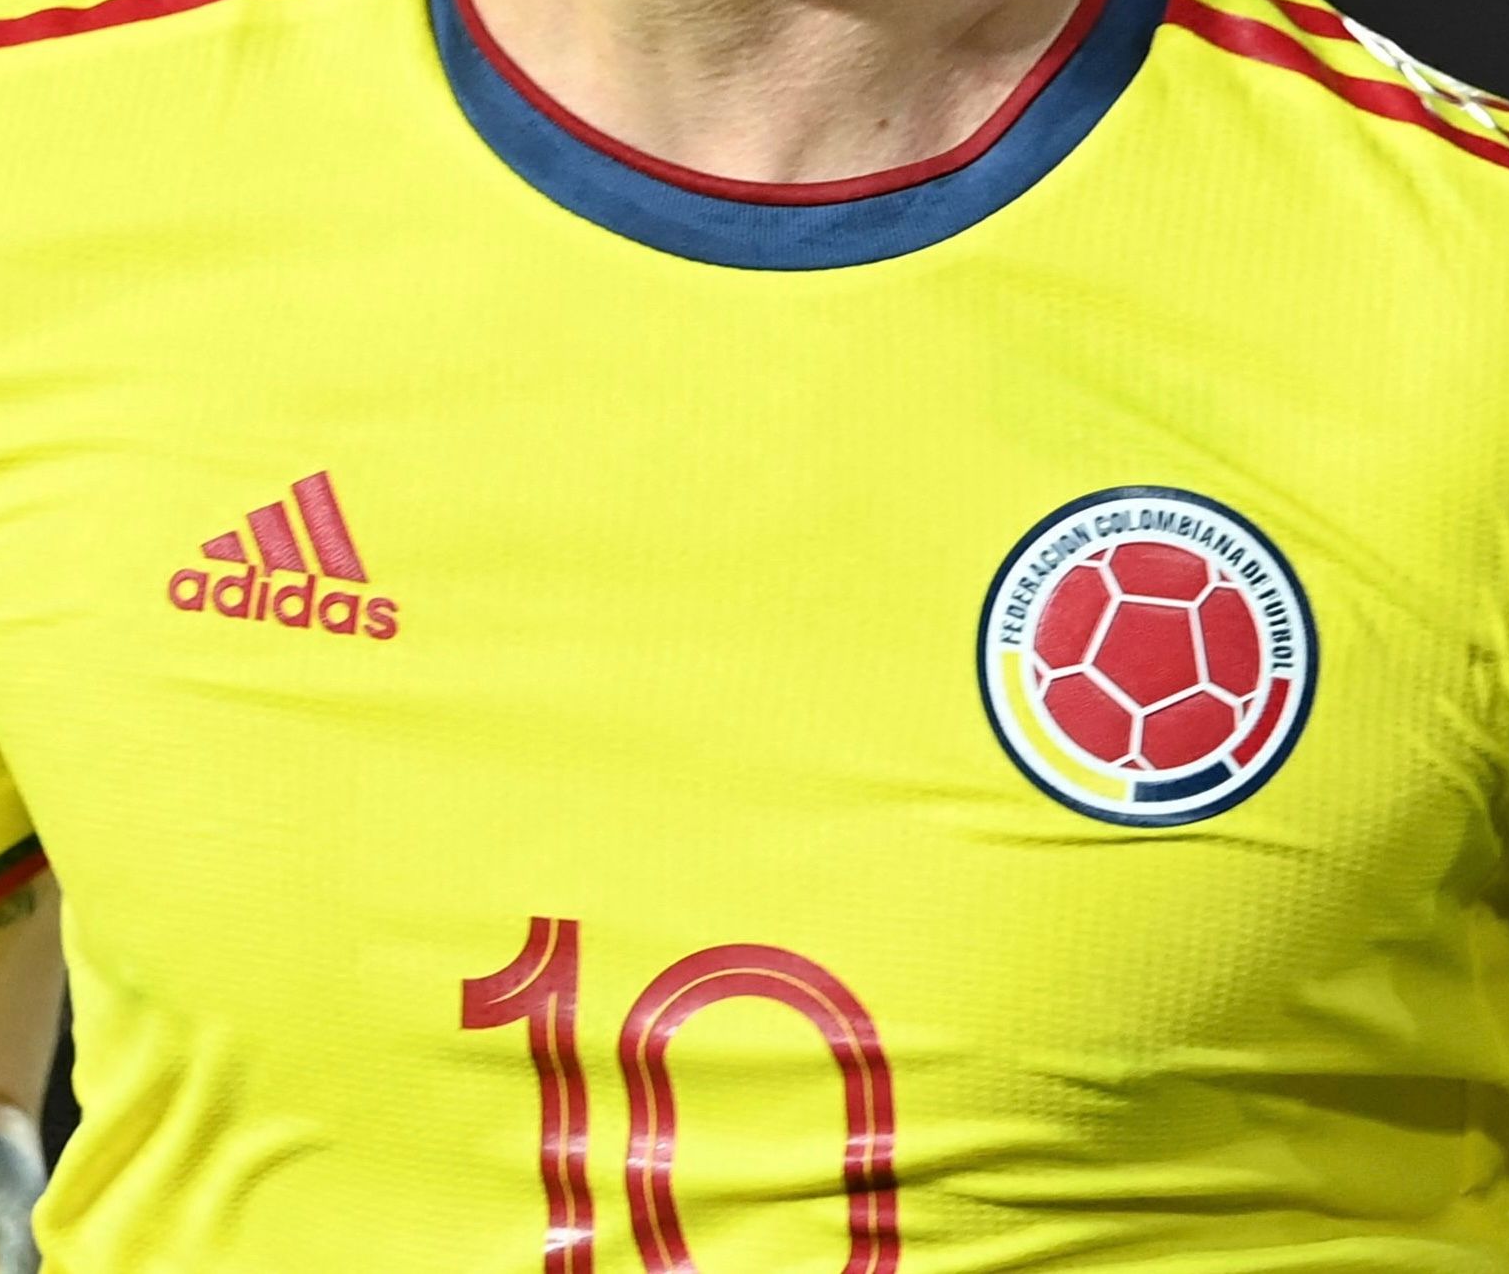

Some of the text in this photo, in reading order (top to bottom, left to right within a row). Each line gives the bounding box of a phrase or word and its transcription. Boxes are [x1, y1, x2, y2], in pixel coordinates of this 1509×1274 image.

[1095, 509, 1246, 567] COLOMBIANA
[1240, 559, 1273, 591] DE
[167, 564, 400, 641] adidas
[1256, 587, 1295, 674] FUTBOL
[460, 916, 902, 1274] 10
